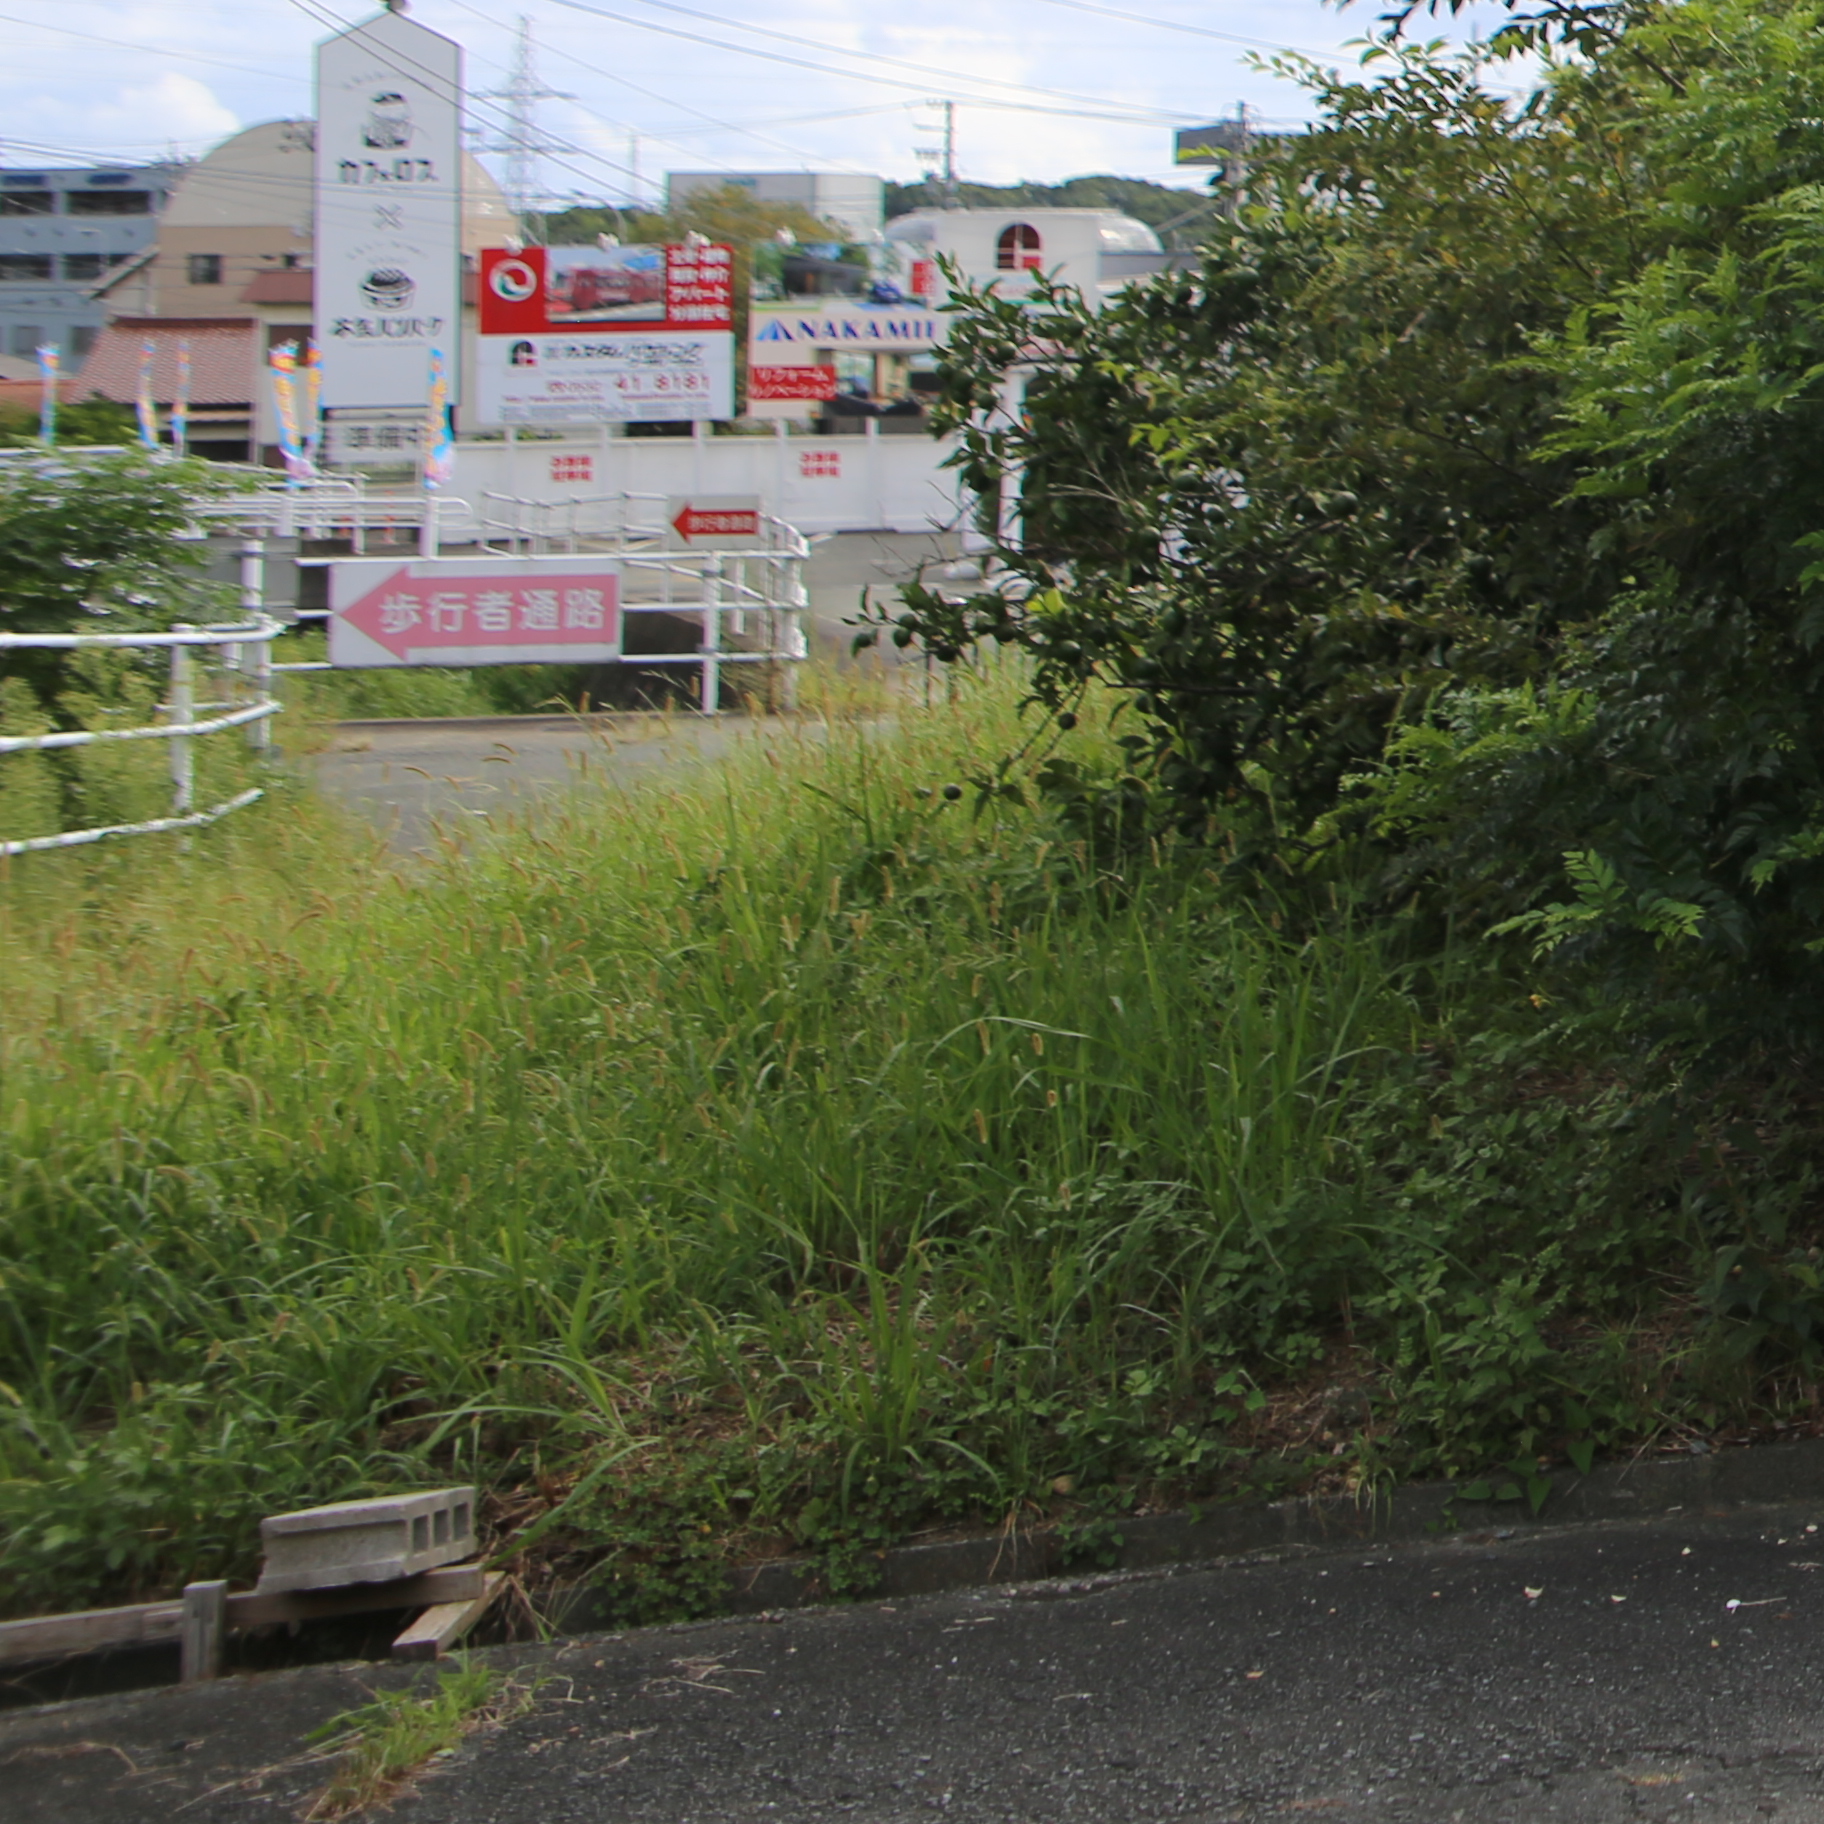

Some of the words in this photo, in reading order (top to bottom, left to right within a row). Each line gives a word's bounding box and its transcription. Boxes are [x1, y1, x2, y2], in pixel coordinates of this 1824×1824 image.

[379, 587, 605, 634] 歩行者通路
